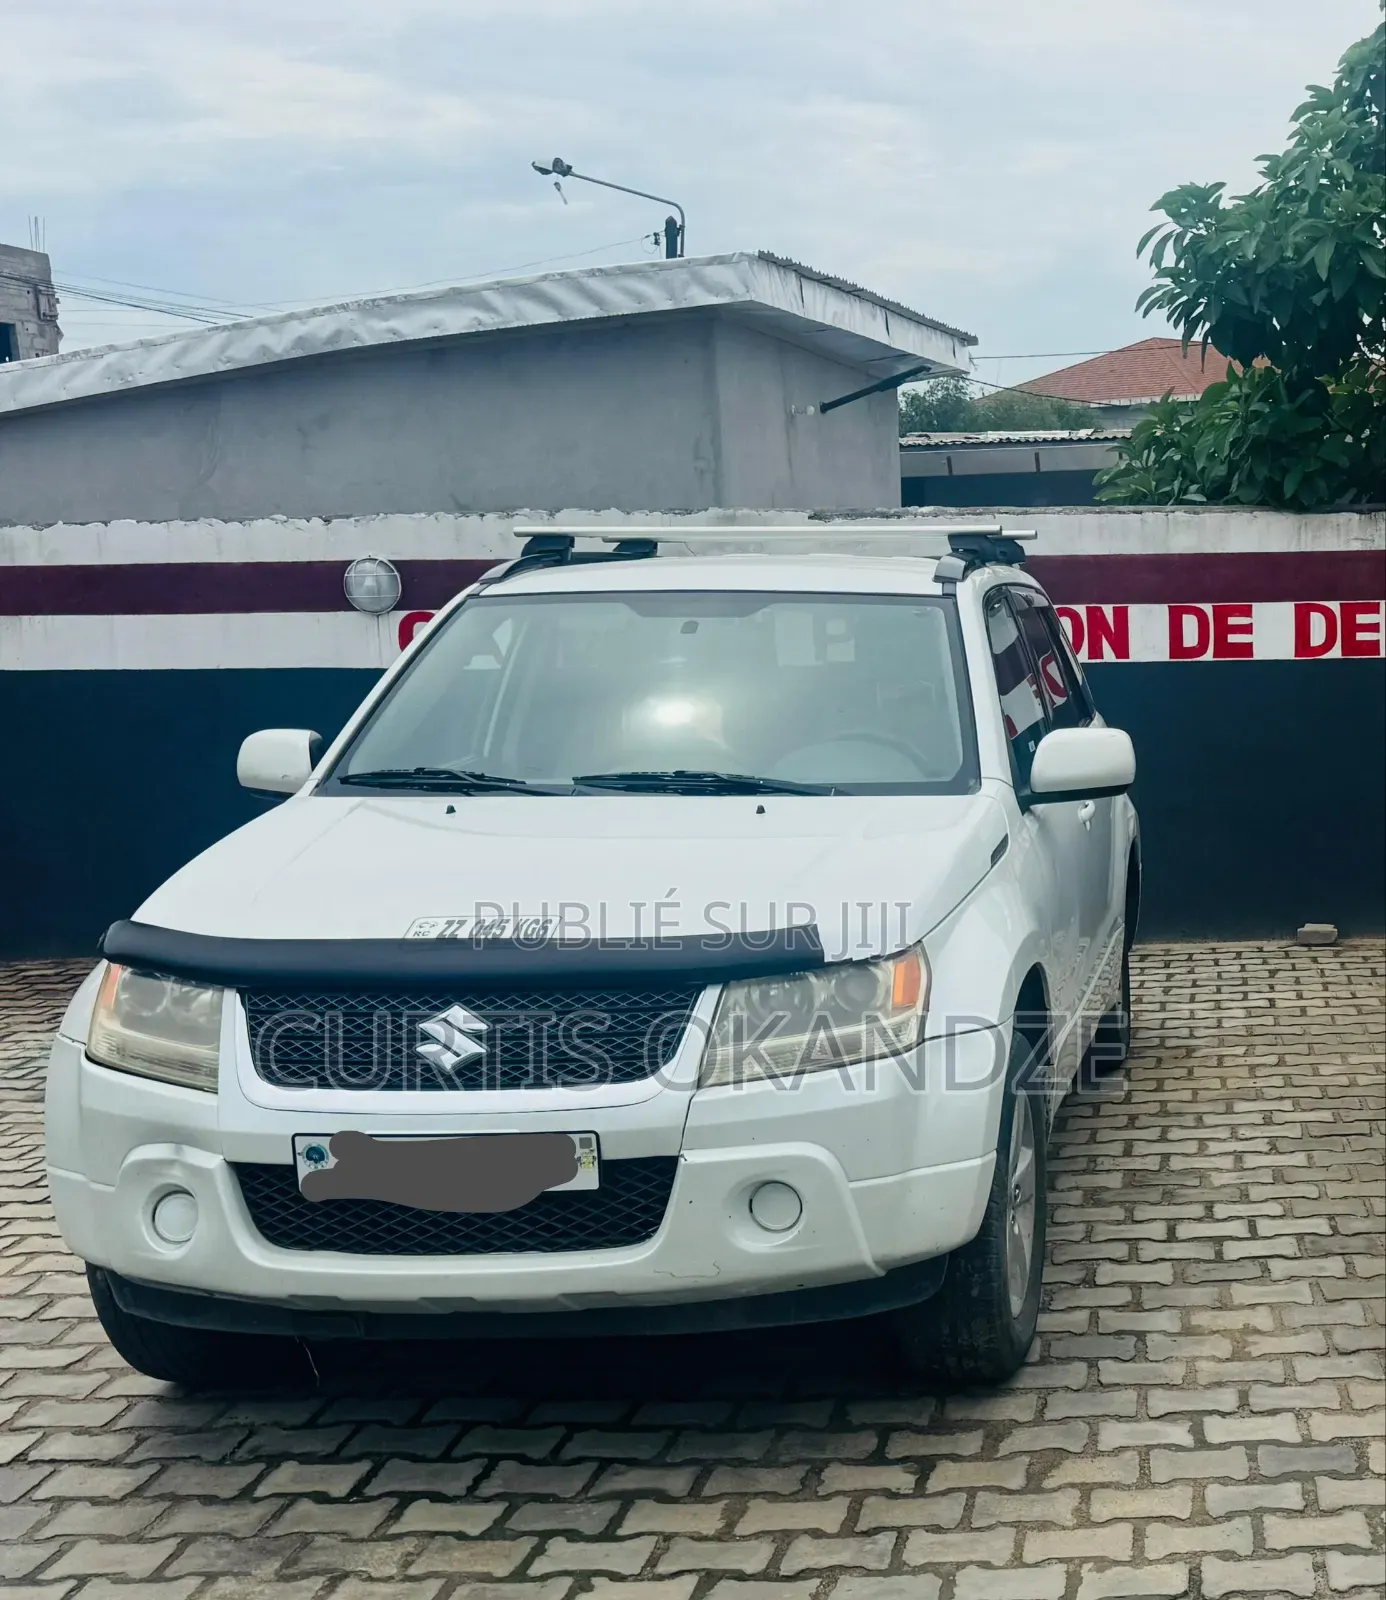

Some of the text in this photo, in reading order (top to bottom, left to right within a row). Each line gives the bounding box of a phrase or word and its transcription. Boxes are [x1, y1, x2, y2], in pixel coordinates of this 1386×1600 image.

[1168, 604, 1254, 660] DE
[435, 919, 468, 939] ZZ
[468, 918, 511, 940] 045
